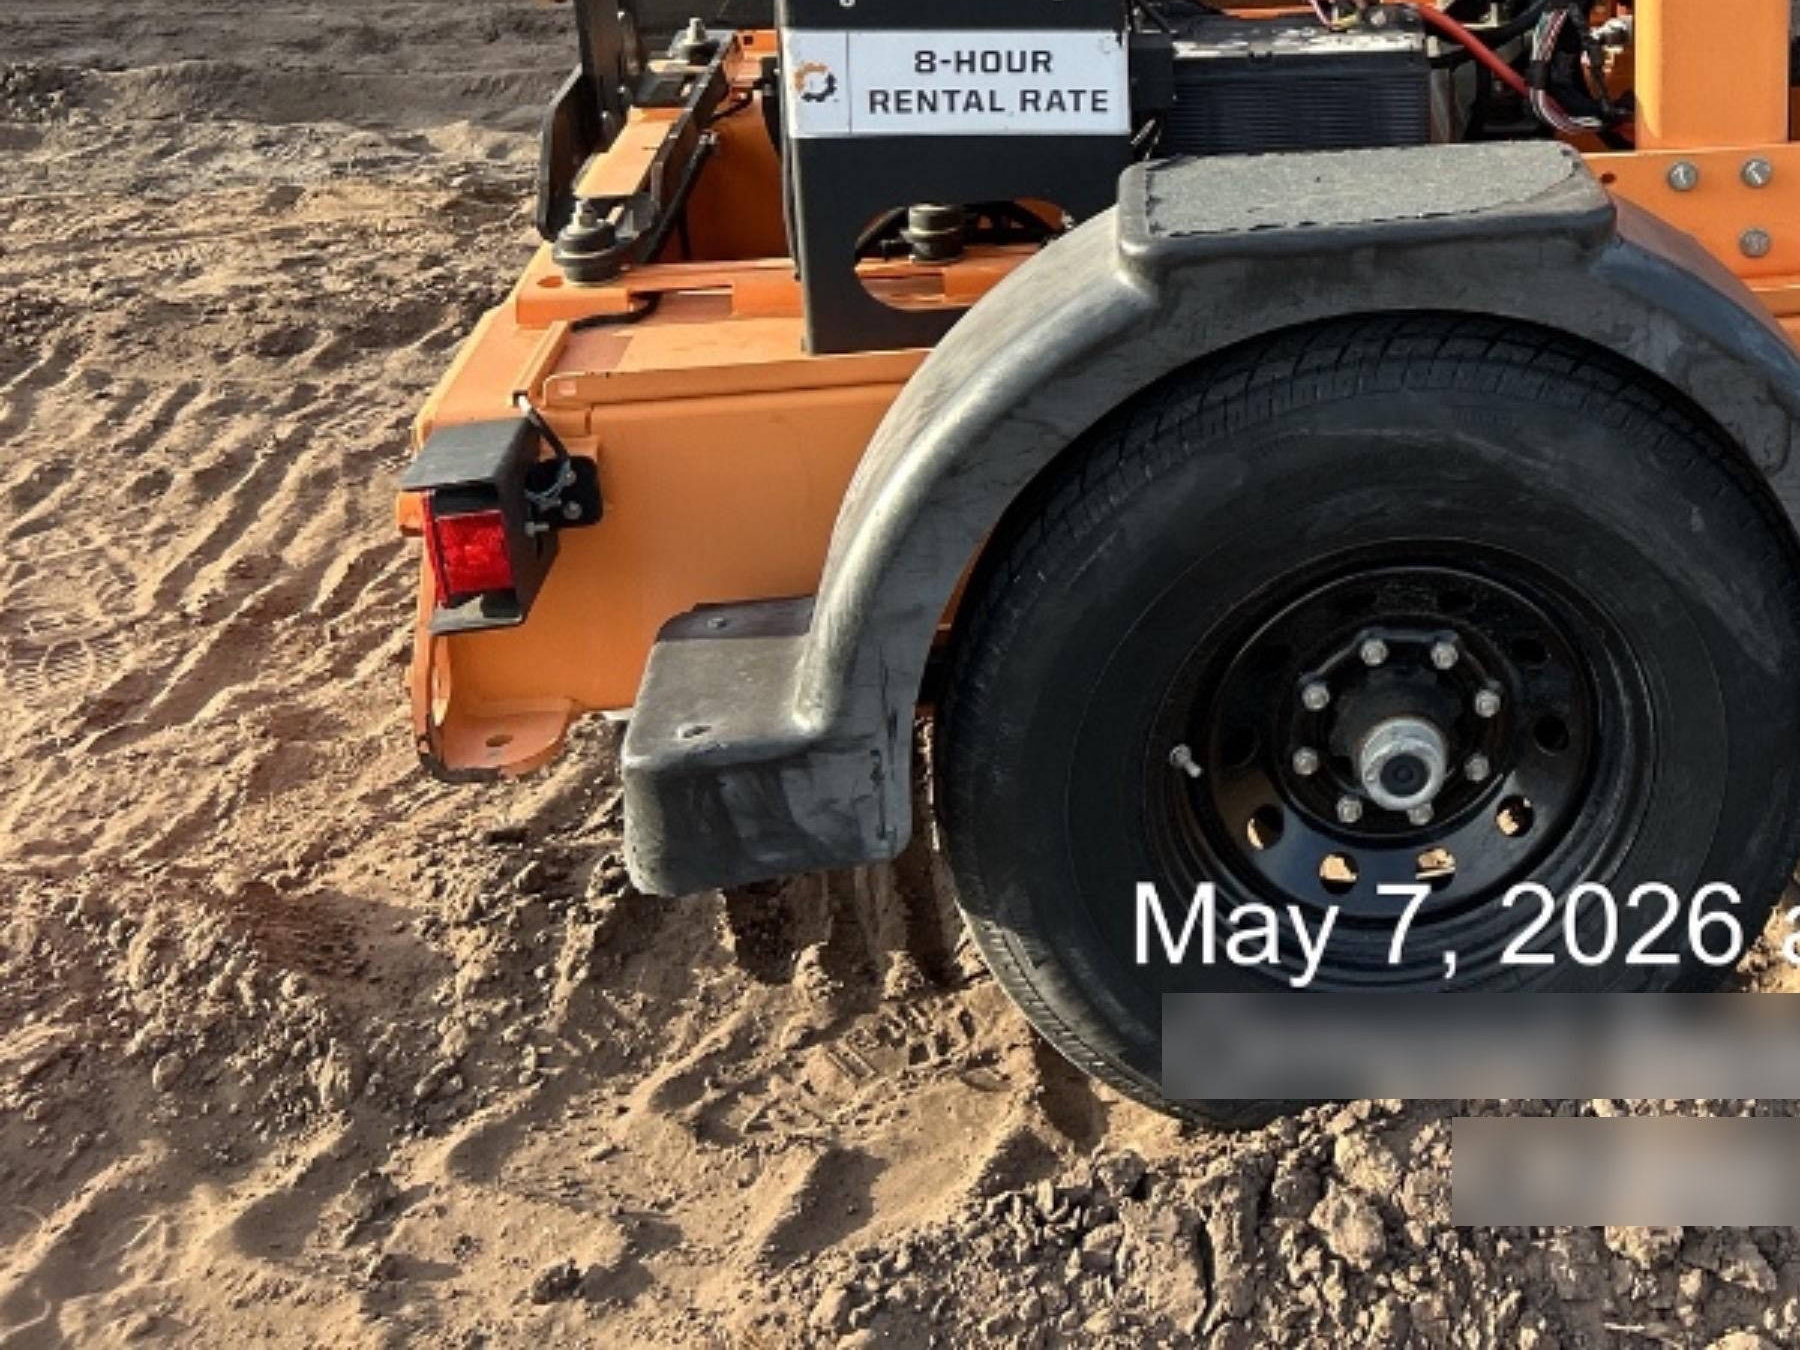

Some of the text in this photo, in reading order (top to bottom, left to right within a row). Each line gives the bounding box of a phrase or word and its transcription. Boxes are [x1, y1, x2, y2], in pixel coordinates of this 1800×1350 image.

[914, 49, 1053, 75] 8-HOUR
[868, 88, 1109, 114] RENTAL RATE
